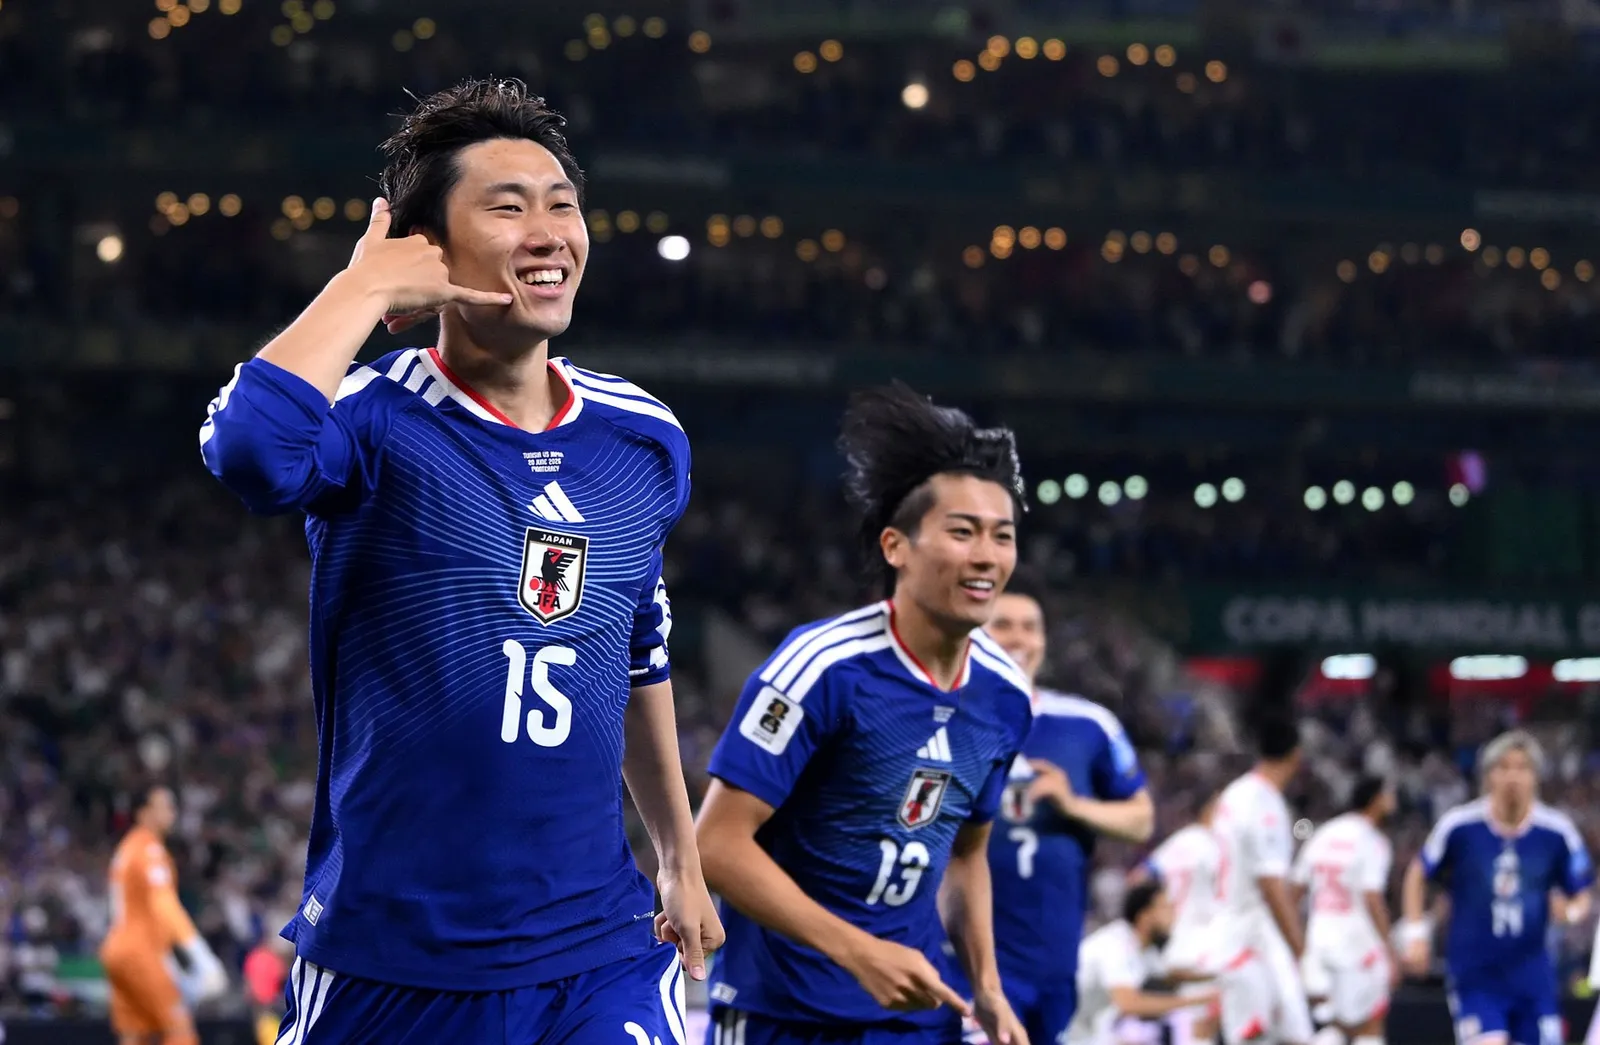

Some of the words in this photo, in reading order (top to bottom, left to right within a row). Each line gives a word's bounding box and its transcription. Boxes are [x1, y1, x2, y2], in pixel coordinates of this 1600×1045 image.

[540, 532, 573, 546] JAPAN
[532, 592, 561, 610] JFA
[1222, 597, 1354, 643] COPA
[1361, 600, 1568, 649] MUNDIAL
[500, 638, 577, 748] 15
[865, 838, 931, 907] 13
[1006, 826, 1040, 880] 7
